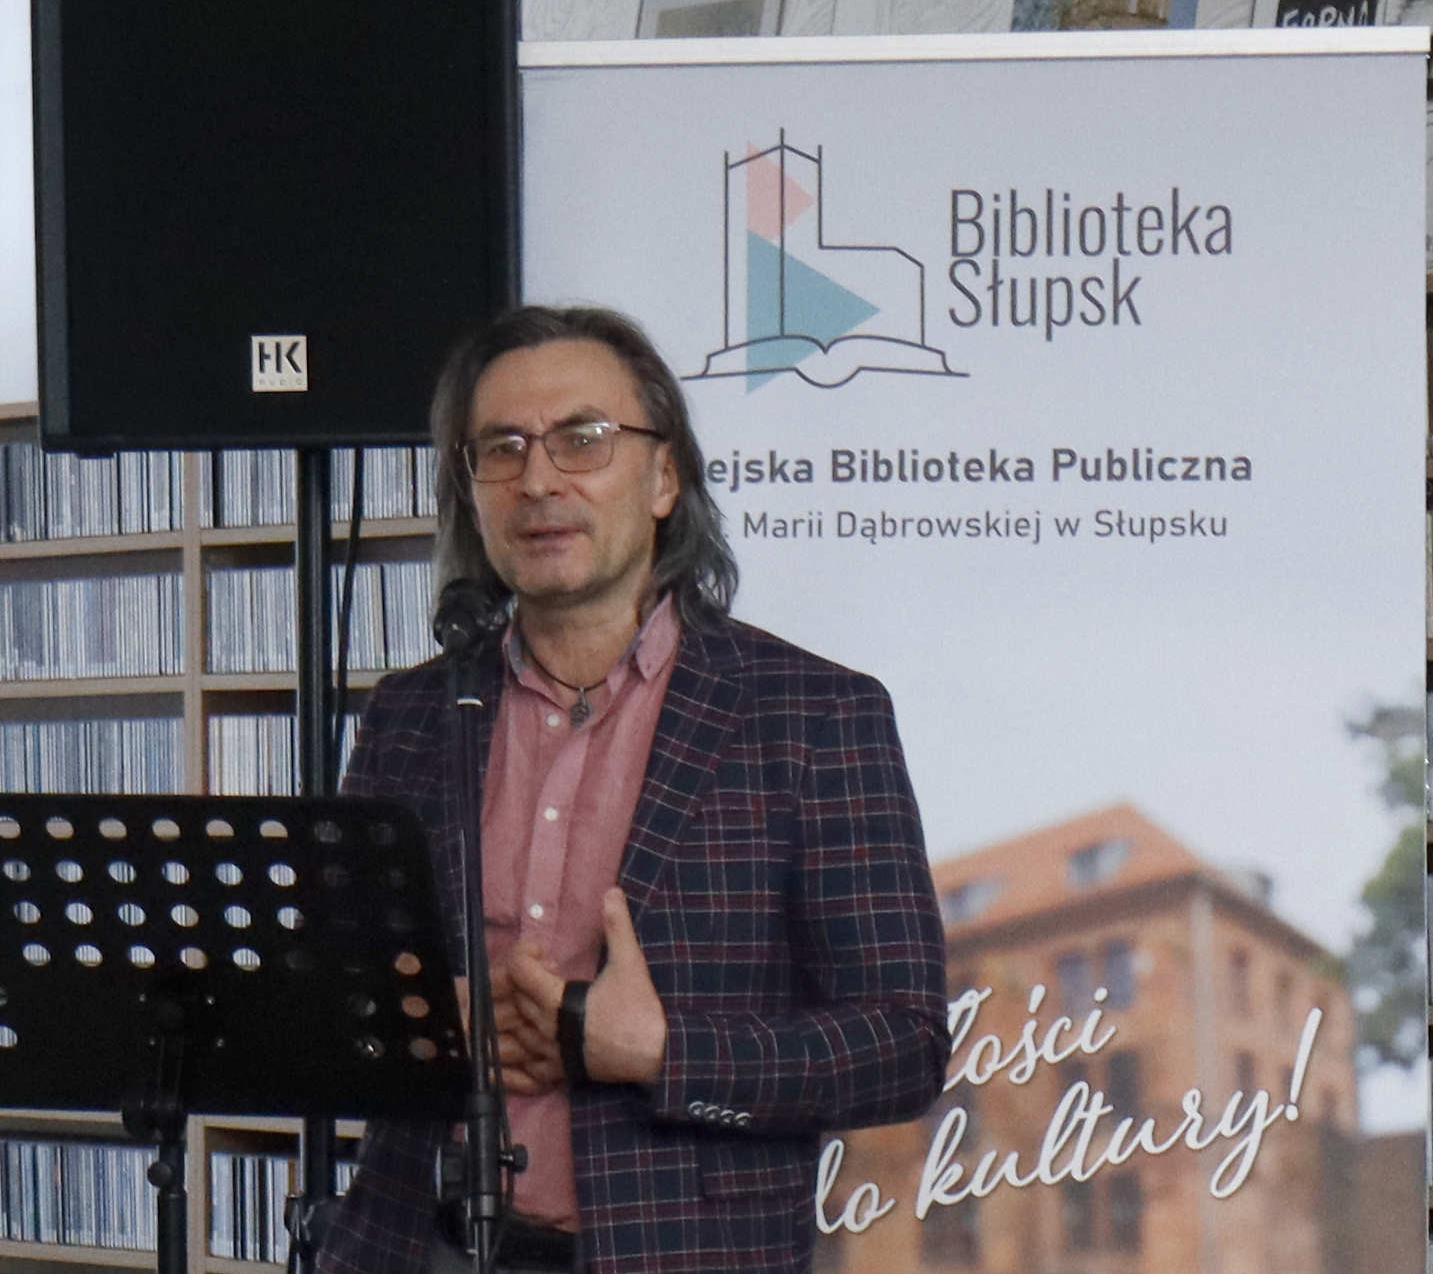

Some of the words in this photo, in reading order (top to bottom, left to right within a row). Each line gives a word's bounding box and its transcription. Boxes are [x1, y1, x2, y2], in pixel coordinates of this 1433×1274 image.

[948, 187, 1234, 257] Biblioteka
[948, 257, 1144, 342] Słupsk
[258, 341, 303, 375] HK
[706, 449, 814, 494] ejska
[831, 447, 1036, 484] Biblioteka
[1051, 445, 1253, 484] Publiczna
[743, 510, 825, 540] Marii
[835, 506, 1043, 545] Dąbrowskiej
[1054, 517, 1081, 539] w
[1093, 507, 1228, 543] Słupsku
[915, 1007, 1323, 1222] kultury!
